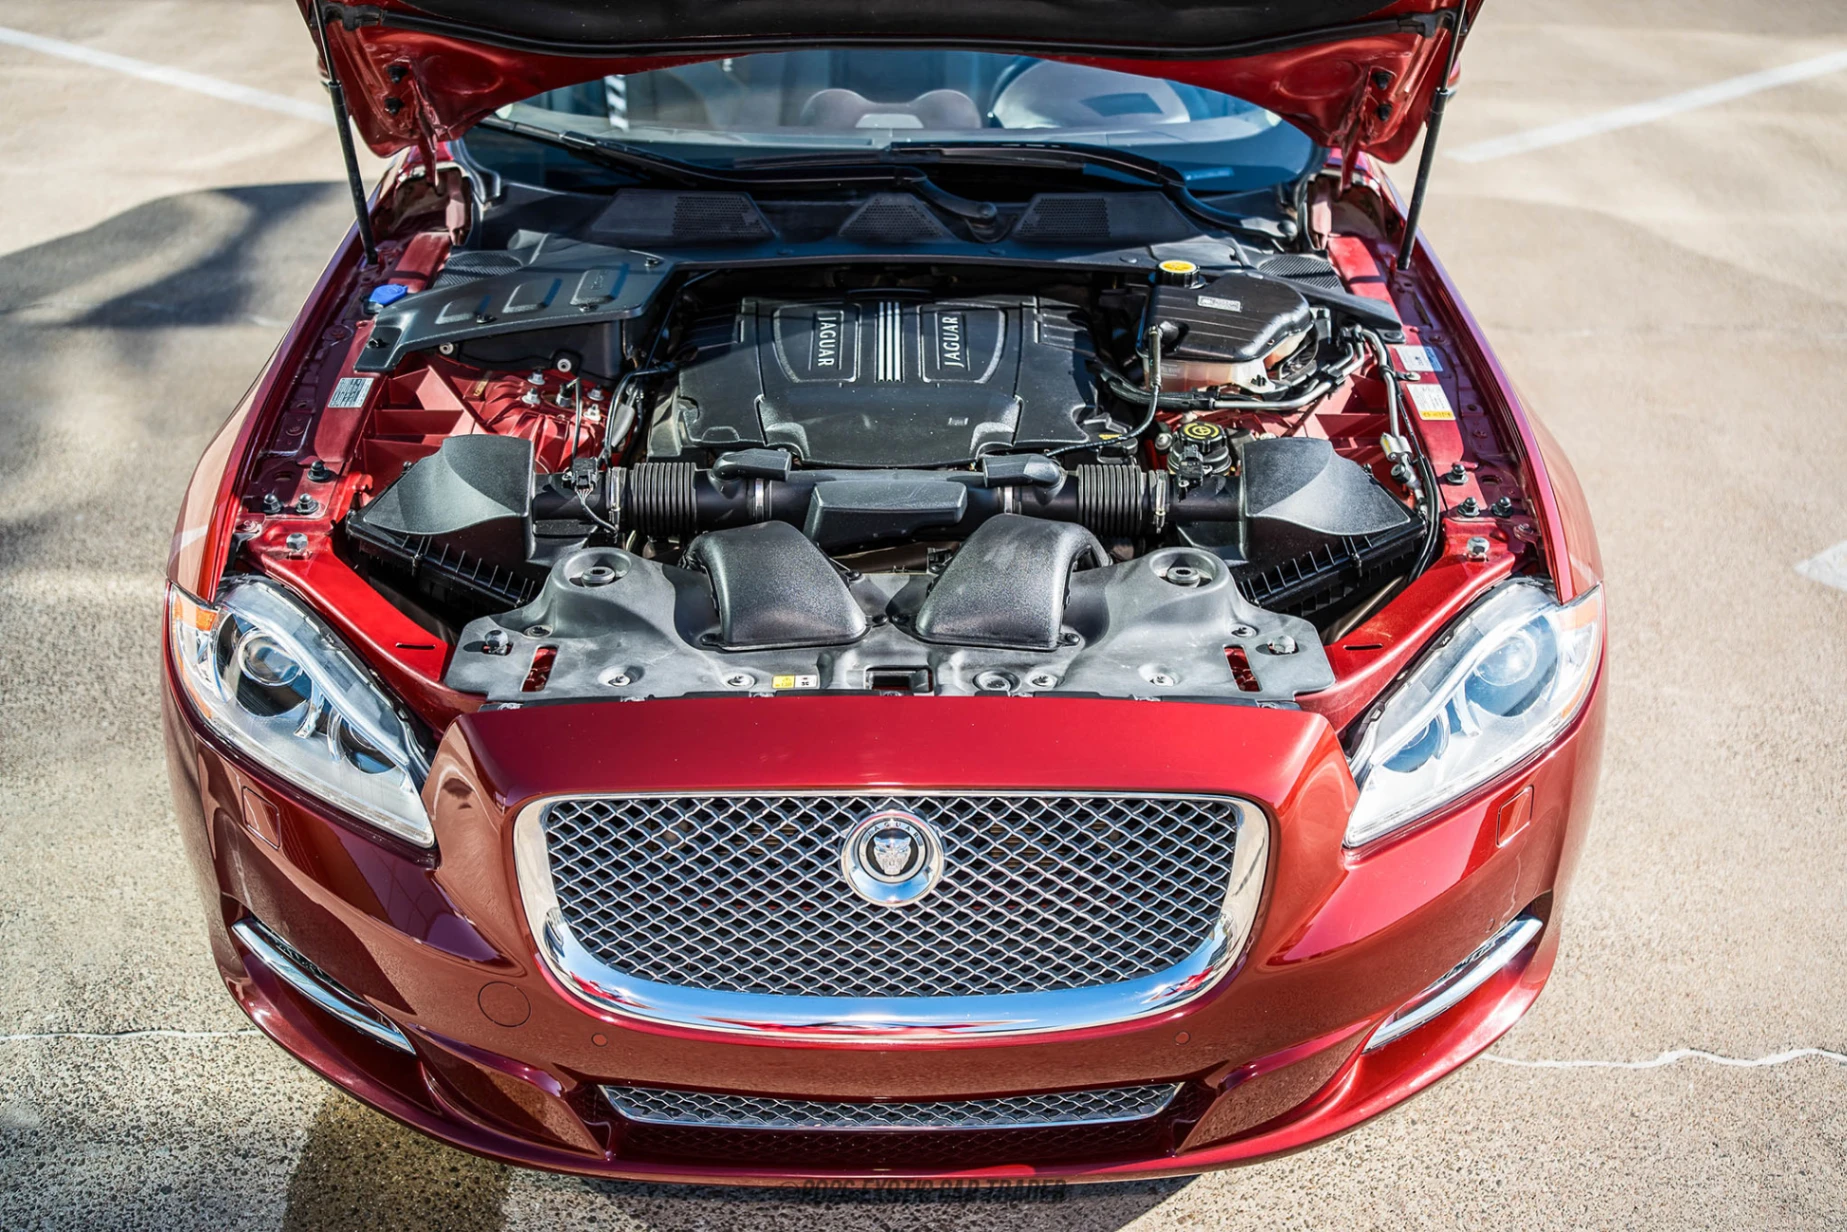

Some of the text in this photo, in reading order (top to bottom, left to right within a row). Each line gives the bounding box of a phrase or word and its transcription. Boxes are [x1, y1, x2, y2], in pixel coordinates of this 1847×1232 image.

[817, 316, 837, 367] JAGUAR
[942, 316, 965, 368] JAGUAR
[867, 822, 920, 838] JAGUAR
